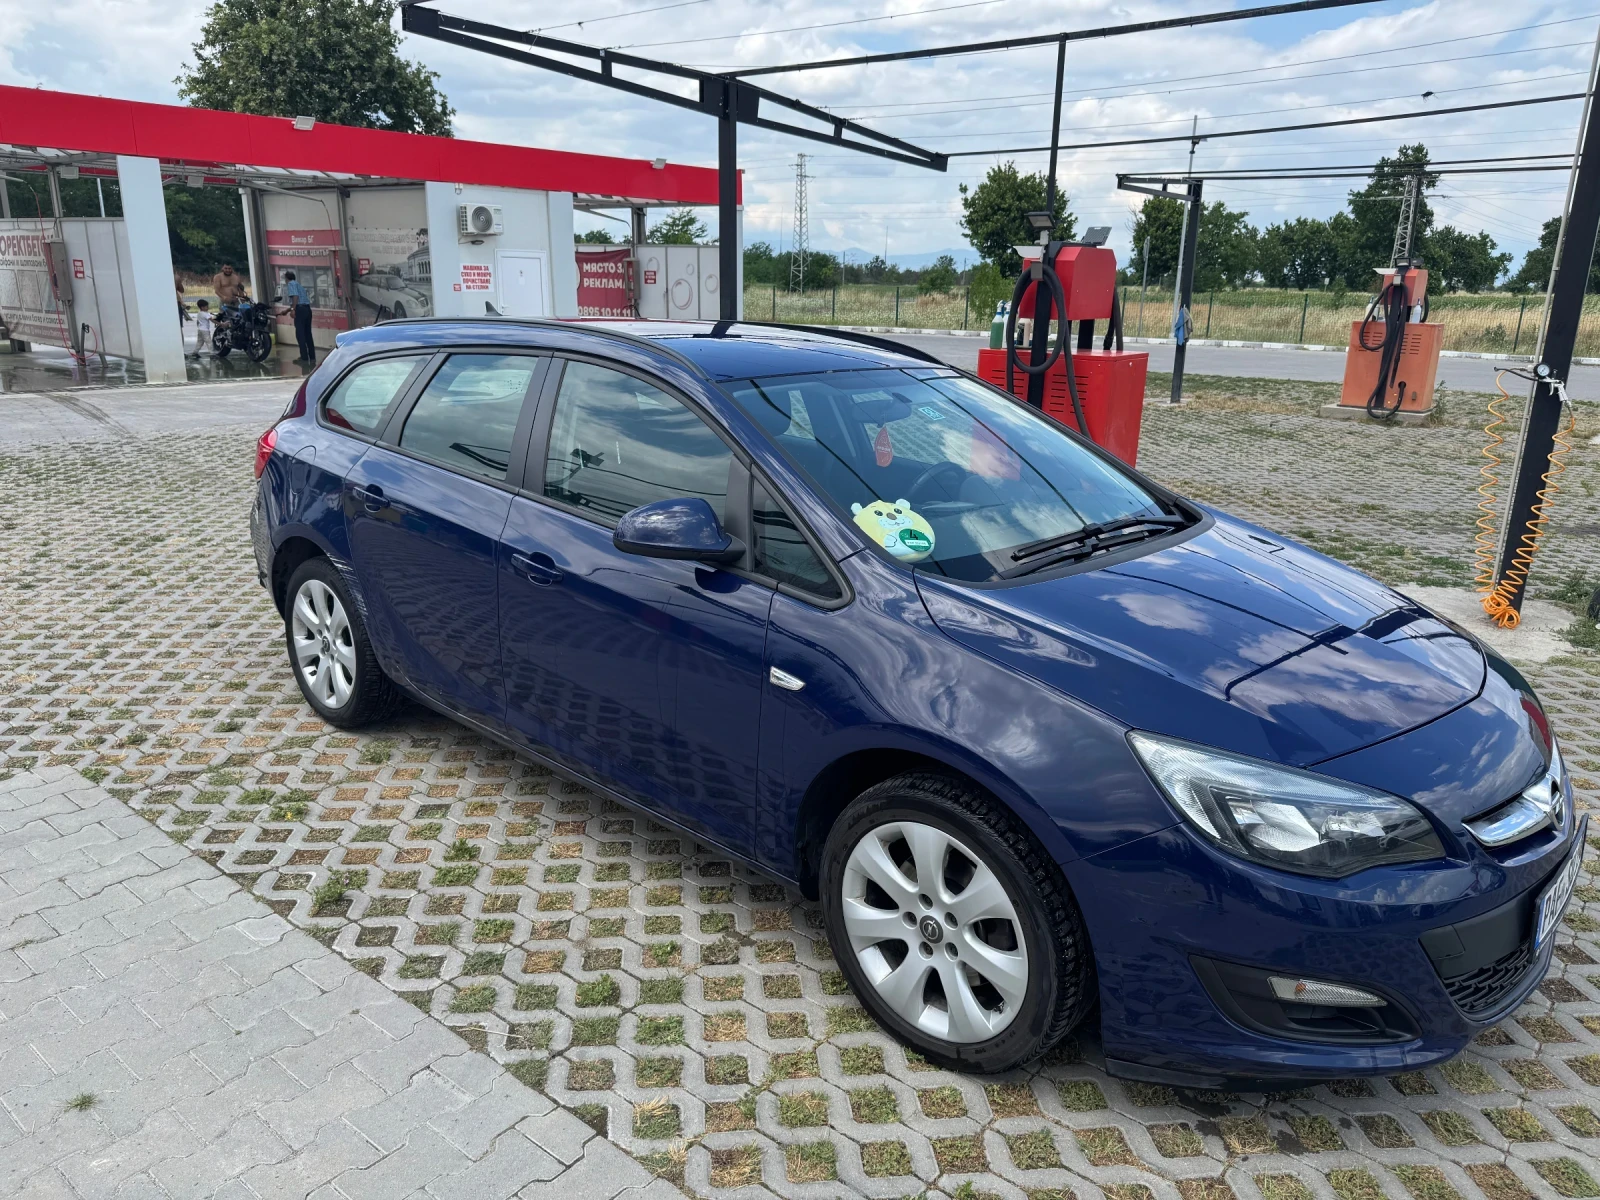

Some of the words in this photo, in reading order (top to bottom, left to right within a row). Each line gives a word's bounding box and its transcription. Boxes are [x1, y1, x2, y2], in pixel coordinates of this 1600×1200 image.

[583, 262, 616, 274] МЯСТО
[578, 306, 599, 317] 0895
[601, 307, 611, 317] 10
